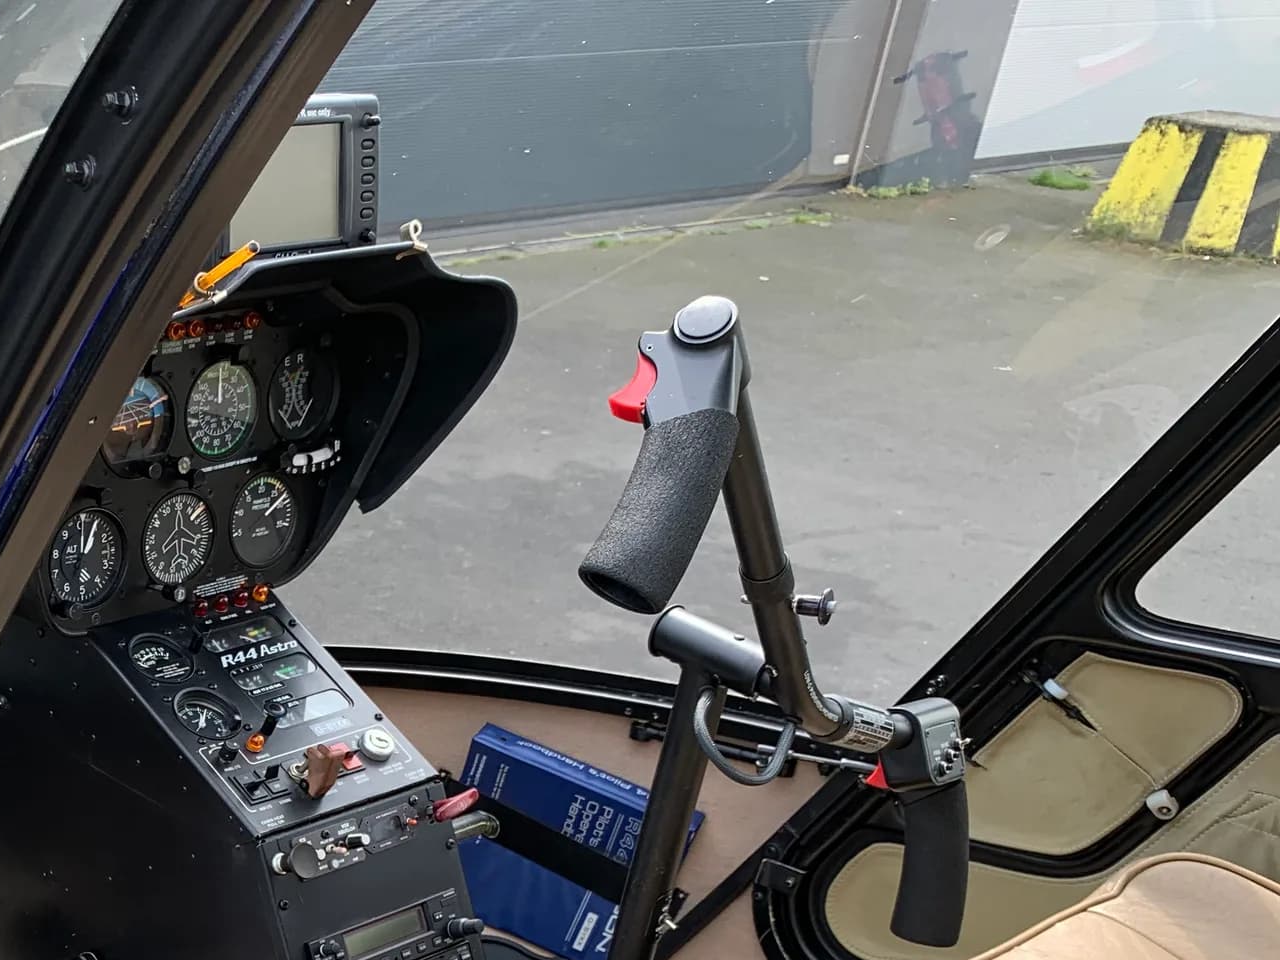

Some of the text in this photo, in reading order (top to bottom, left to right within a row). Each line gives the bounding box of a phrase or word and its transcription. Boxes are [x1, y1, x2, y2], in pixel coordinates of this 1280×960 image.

[61, 530, 68, 540] 9
[101, 533, 108, 543] 2
[52, 549, 59, 559] 8
[66, 544, 78, 554] ALT
[102, 559, 109, 570] 3
[52, 569, 59, 579] 7
[63, 582, 70, 592] 6
[79, 585, 86, 595] 5
[220, 639, 299, 668] R44 Astro
[574, 800, 599, 844] Opera
[588, 805, 615, 848] Pilot's
